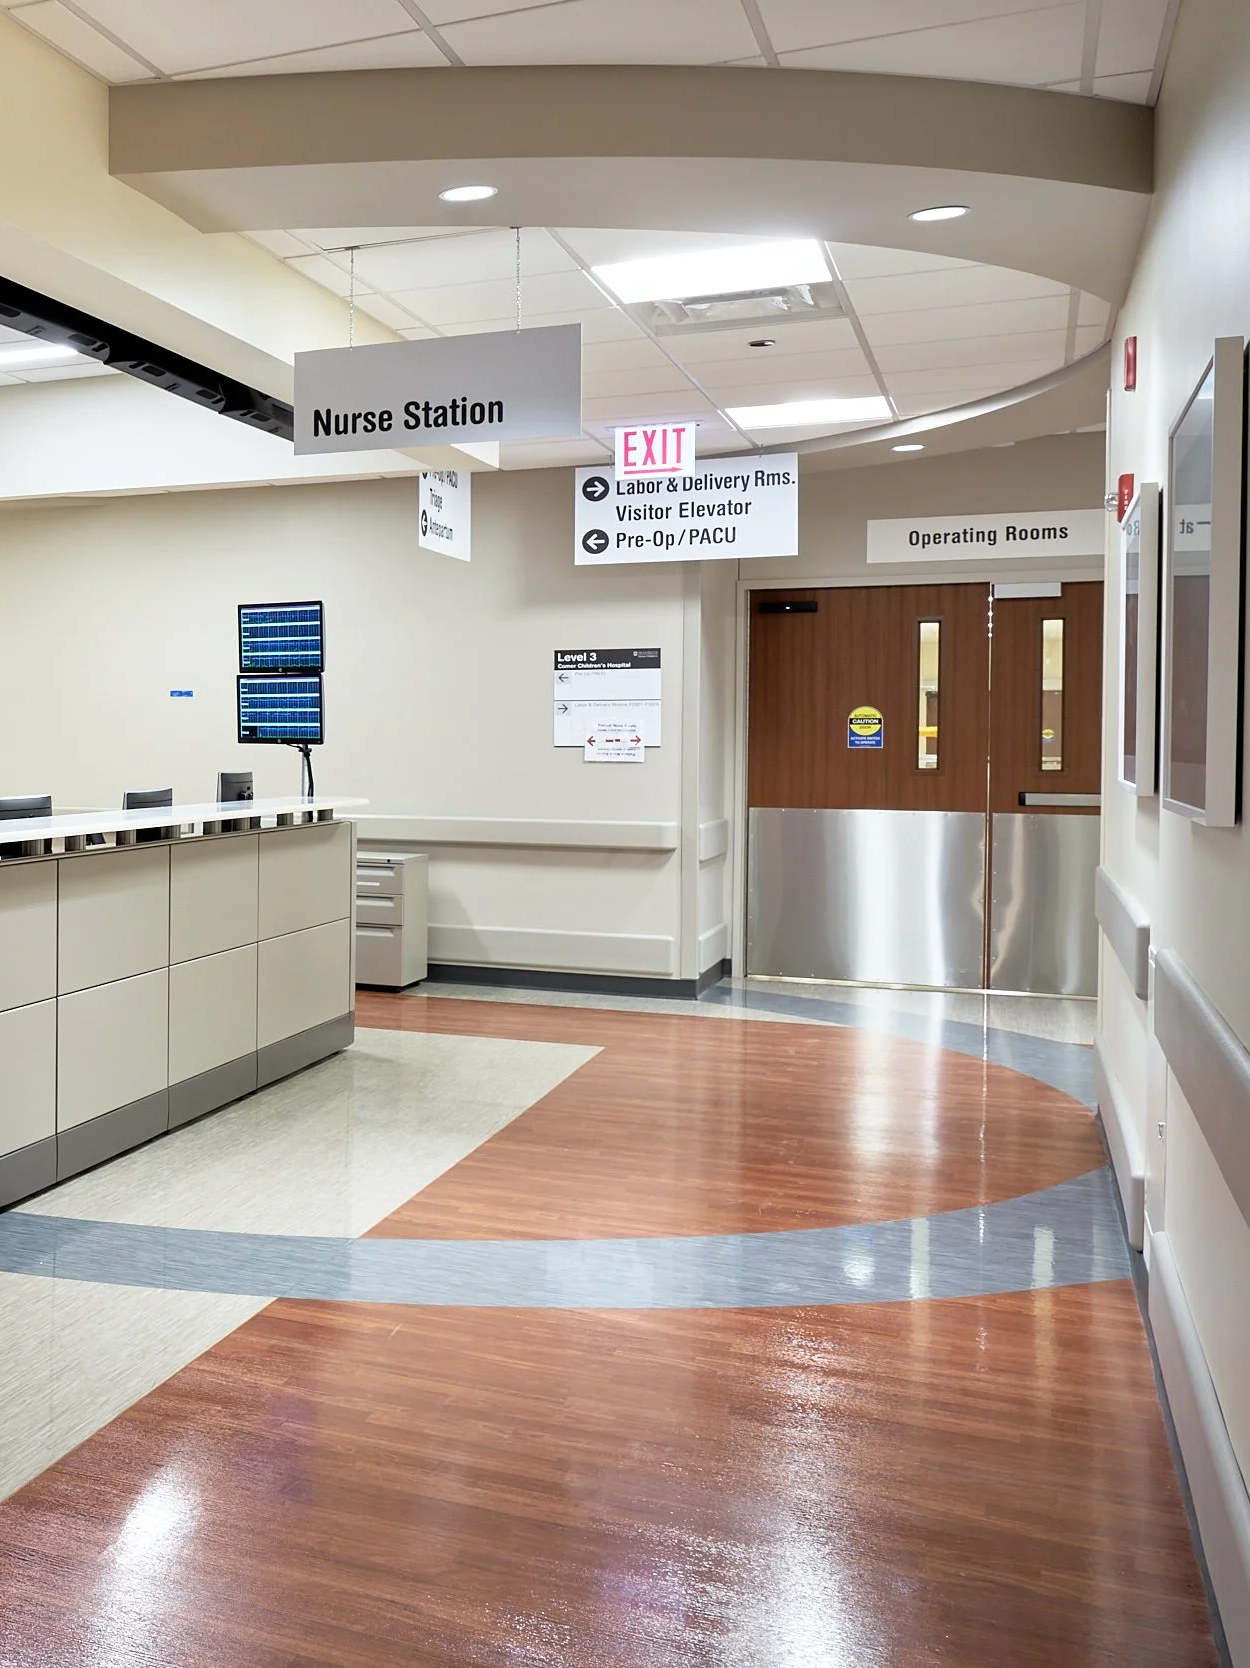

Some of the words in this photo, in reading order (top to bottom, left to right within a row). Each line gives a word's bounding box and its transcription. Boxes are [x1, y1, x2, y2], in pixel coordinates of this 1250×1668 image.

[313, 408, 393, 437] Nurse
[403, 396, 504, 430] Station
[623, 427, 686, 467] EXIT
[616, 480, 663, 496] Labor
[666, 477, 679, 492] &
[682, 473, 750, 493] Delivery
[754, 469, 796, 487] Rms.
[616, 504, 672, 522] Visitor
[679, 500, 752, 518] Elevator
[908, 527, 997, 549] Operating
[1005, 525, 1069, 542] Rooms
[557, 652, 587, 662] Level
[589, 652, 597, 662] 3
